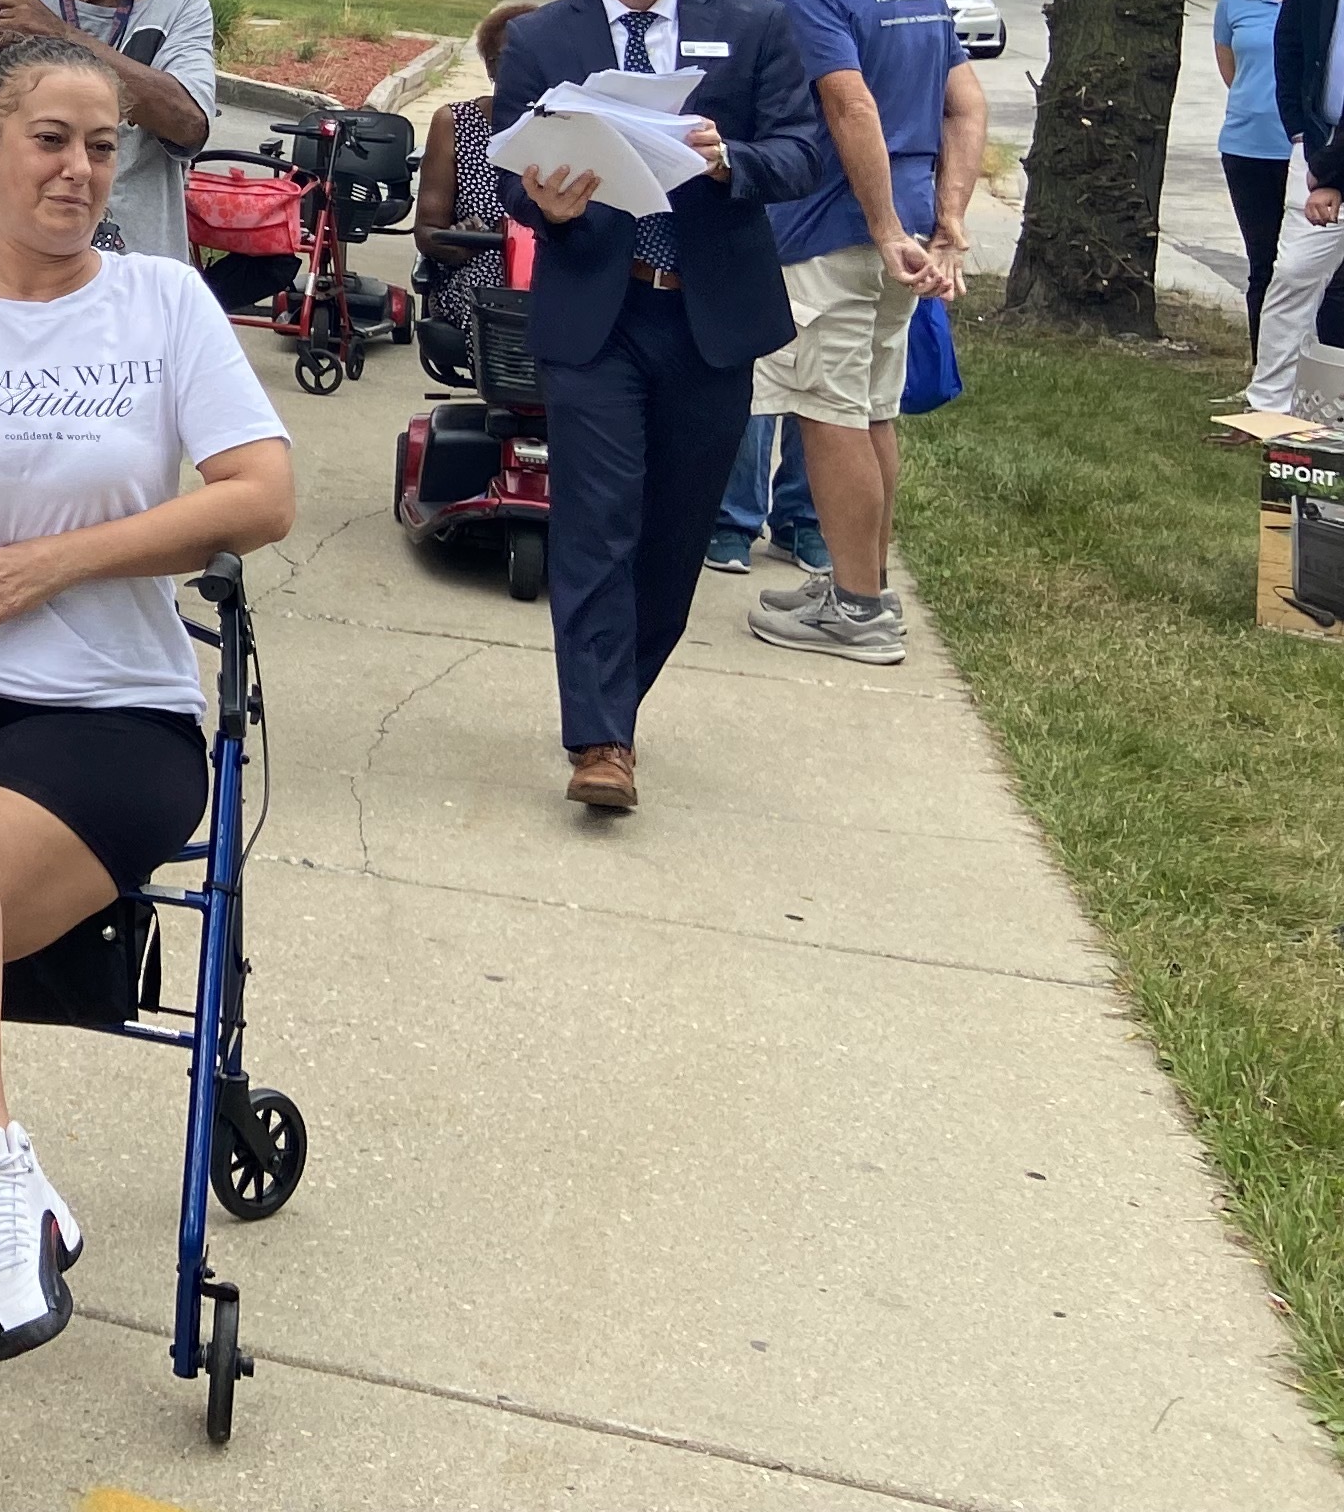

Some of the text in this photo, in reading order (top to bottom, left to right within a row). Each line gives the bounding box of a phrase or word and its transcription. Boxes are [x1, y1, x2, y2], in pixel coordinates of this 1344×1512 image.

[72, 358, 163, 387] WITH
[4, 431, 102, 443] confident & worthy
[1269, 462, 1337, 487] SPORT
